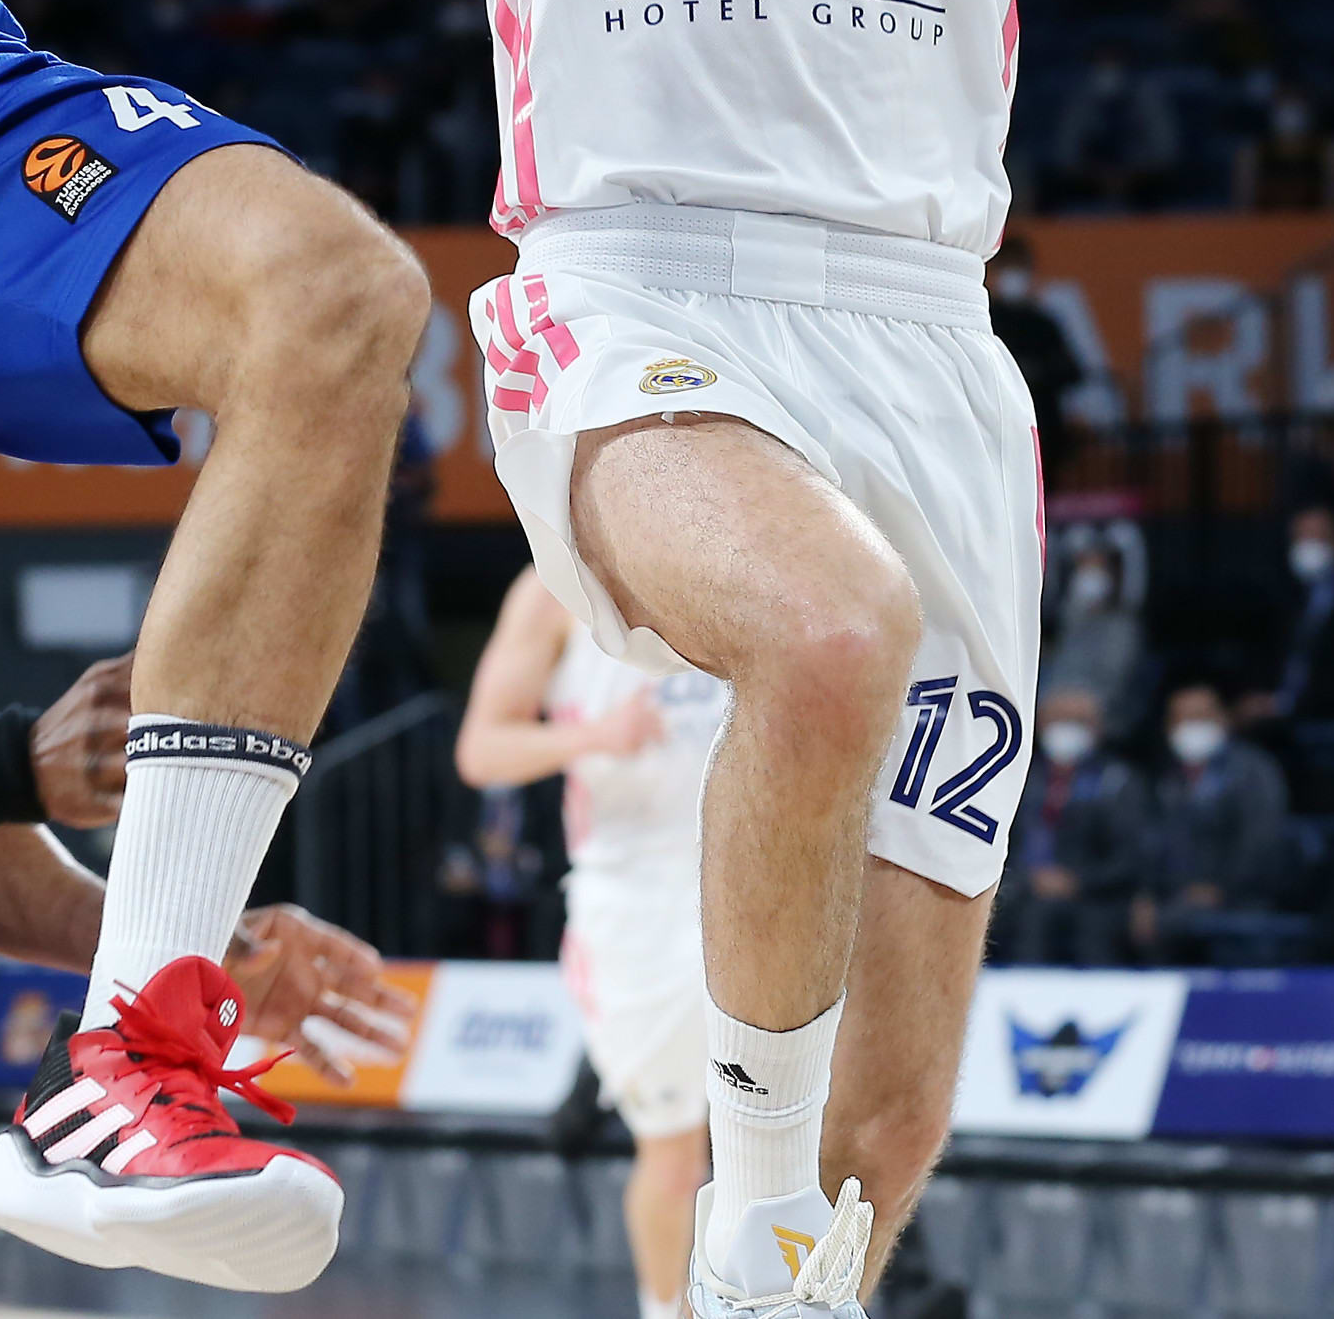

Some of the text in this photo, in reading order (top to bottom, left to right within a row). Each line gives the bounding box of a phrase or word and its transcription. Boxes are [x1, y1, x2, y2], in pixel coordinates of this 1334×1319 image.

[605, 0, 946, 47] HOTEL GROUP
[55, 159, 102, 205] TURKISH
[63, 164, 107, 212] AIRLINES
[67, 169, 112, 217] EuroLeague
[125, 731, 237, 755] adidas
[889, 675, 1023, 845] 12
